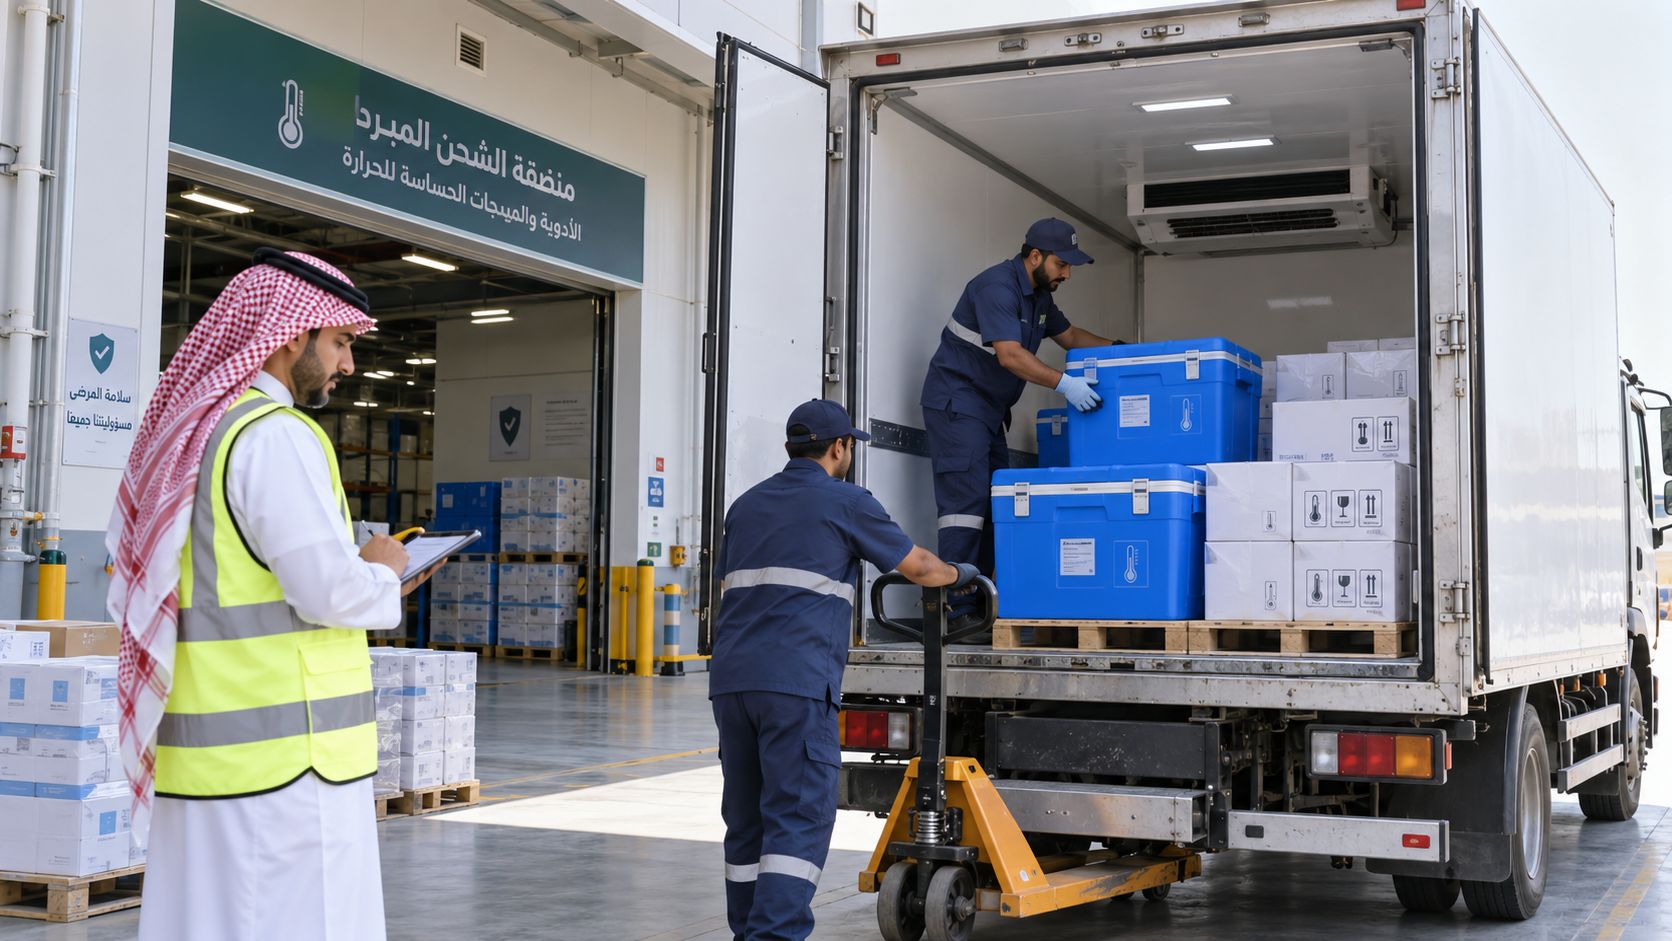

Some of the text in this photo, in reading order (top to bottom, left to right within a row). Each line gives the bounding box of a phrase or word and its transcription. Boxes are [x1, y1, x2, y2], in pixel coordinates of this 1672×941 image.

[342, 145, 396, 182] للحرارة
[436, 134, 507, 178] الشحن
[400, 164, 466, 204] الحساسة
[540, 212, 581, 241] الأدوية
[69, 385, 131, 404] سلامة المرضى
